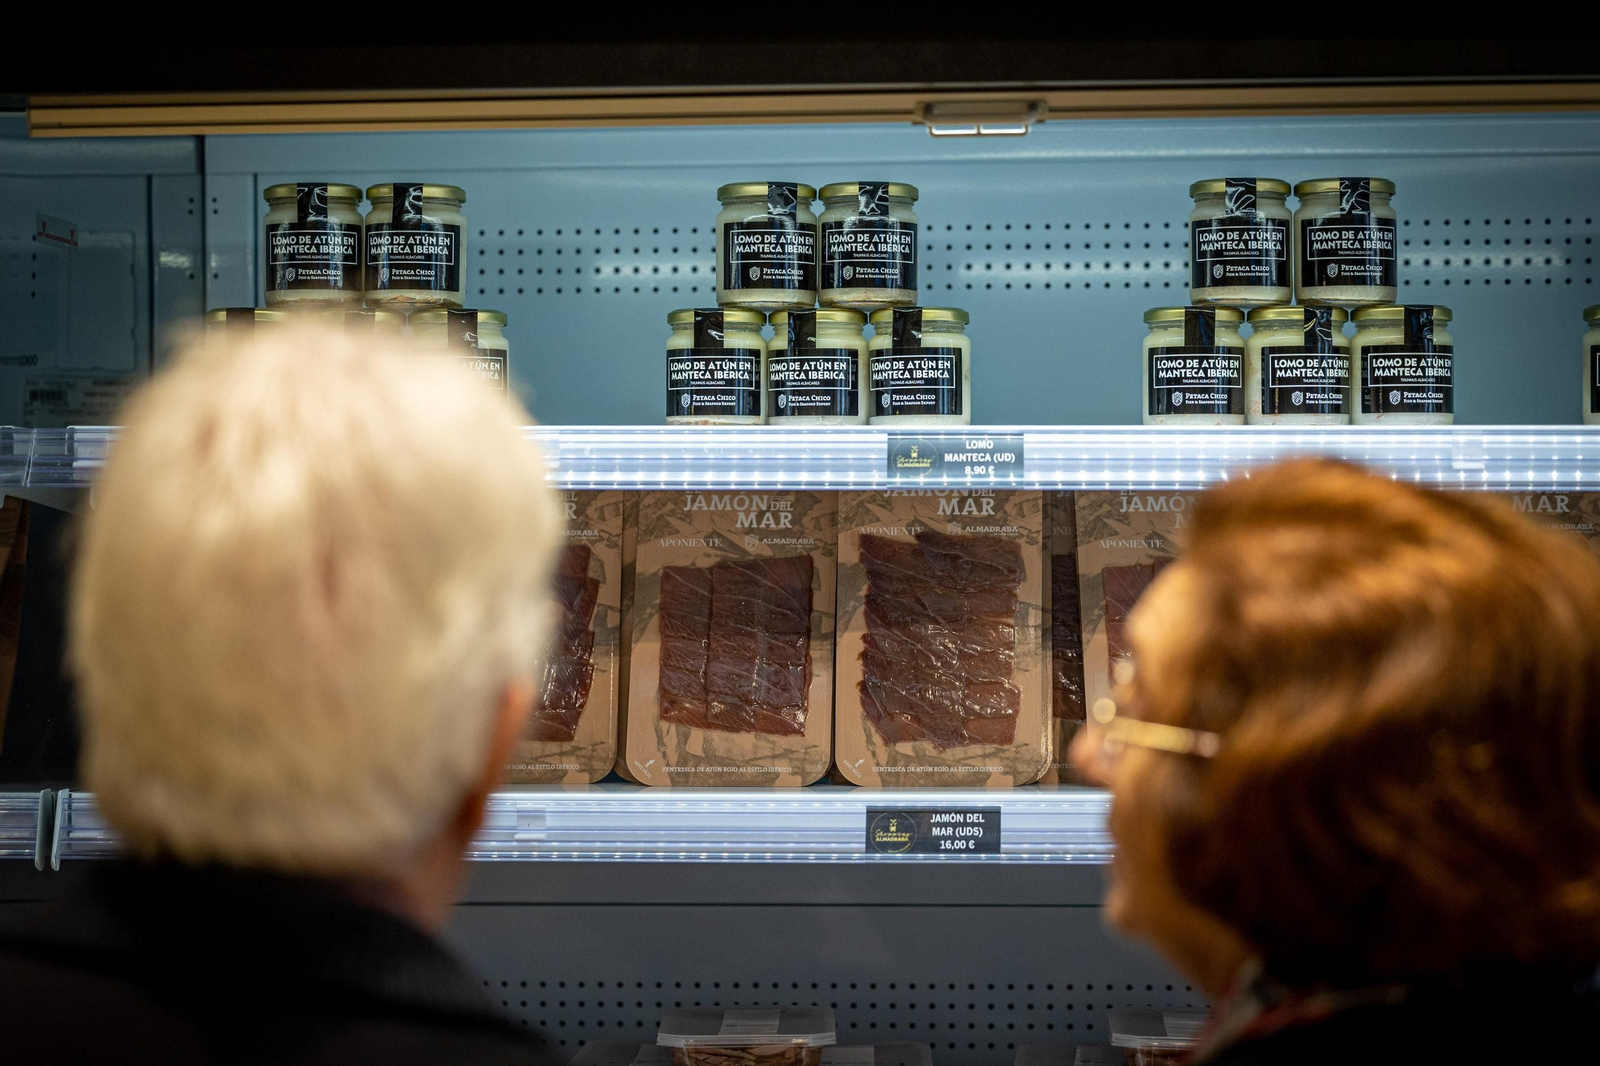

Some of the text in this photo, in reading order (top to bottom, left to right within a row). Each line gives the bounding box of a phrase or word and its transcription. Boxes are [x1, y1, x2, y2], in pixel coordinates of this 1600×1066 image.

[273, 236, 296, 245] LOMO
[314, 234, 342, 245] ATÚN
[343, 237, 353, 245] EN
[370, 234, 450, 246] LOMO DE ATÚN EN
[735, 235, 762, 244] LOMO
[780, 234, 804, 244] ATÚN
[830, 233, 911, 244] LOMO DE ATÚN EN
[1200, 230, 1282, 242] LOMO DE ATÚN EN
[1312, 232, 1339, 241] LOMO
[1358, 230, 1382, 240] ATÚN
[1384, 232, 1392, 240] EN
[274, 244, 353, 254] MANTECA IBÉRICA
[371, 244, 448, 255] MANTECA IBÉRICA
[736, 243, 812, 254] MANTECA IBÉRICA
[831, 242, 910, 253] MANTECA IBÉRICA
[1201, 240, 1281, 250] MANTECA IBÉRICA
[1313, 240, 1392, 250] MANTECA IBÉRICA
[671, 362, 691, 370] LOMO
[709, 360, 737, 370] ATÚN
[740, 361, 751, 370] EN
[770, 363, 788, 371] LOMO
[805, 360, 833, 370] ATÚN
[836, 362, 846, 370] EN
[872, 359, 950, 371] LOMO DE ATÚN EN
[1157, 358, 1239, 369] LOMO DE ATÚN EN
[1275, 360, 1302, 368] LOMO
[1306, 359, 1318, 367] DE
[1322, 358, 1342, 368] ATÚN
[1373, 357, 1451, 368] LOMO DE ATÚN EN
[672, 369, 749, 380] MANTECA IBÉRICA
[771, 369, 844, 380] MANTECA IBÉRICA
[873, 369, 949, 380] MANTECA IBÉRICA
[1158, 367, 1238, 378] MANTECA IBÉRICA
[1276, 368, 1325, 377] MANTECA
[1374, 366, 1451, 377] MANTECA IBÉRICA
[966, 441, 993, 449] LOMO
[945, 453, 1015, 463] MANTECA (UD)
[965, 466, 994, 475] 8,90 €
[684, 491, 793, 510] JAMÓN DEL
[1512, 496, 1570, 512] MAR
[938, 498, 995, 515] MAR
[736, 512, 792, 528] MAR
[658, 538, 722, 547] APONIENTE
[1099, 540, 1164, 549] APONIENTE
[930, 812, 984, 822] JAMÓN DEL
[932, 827, 982, 837] MAR (UDS)
[940, 840, 974, 850] 16,00 €
